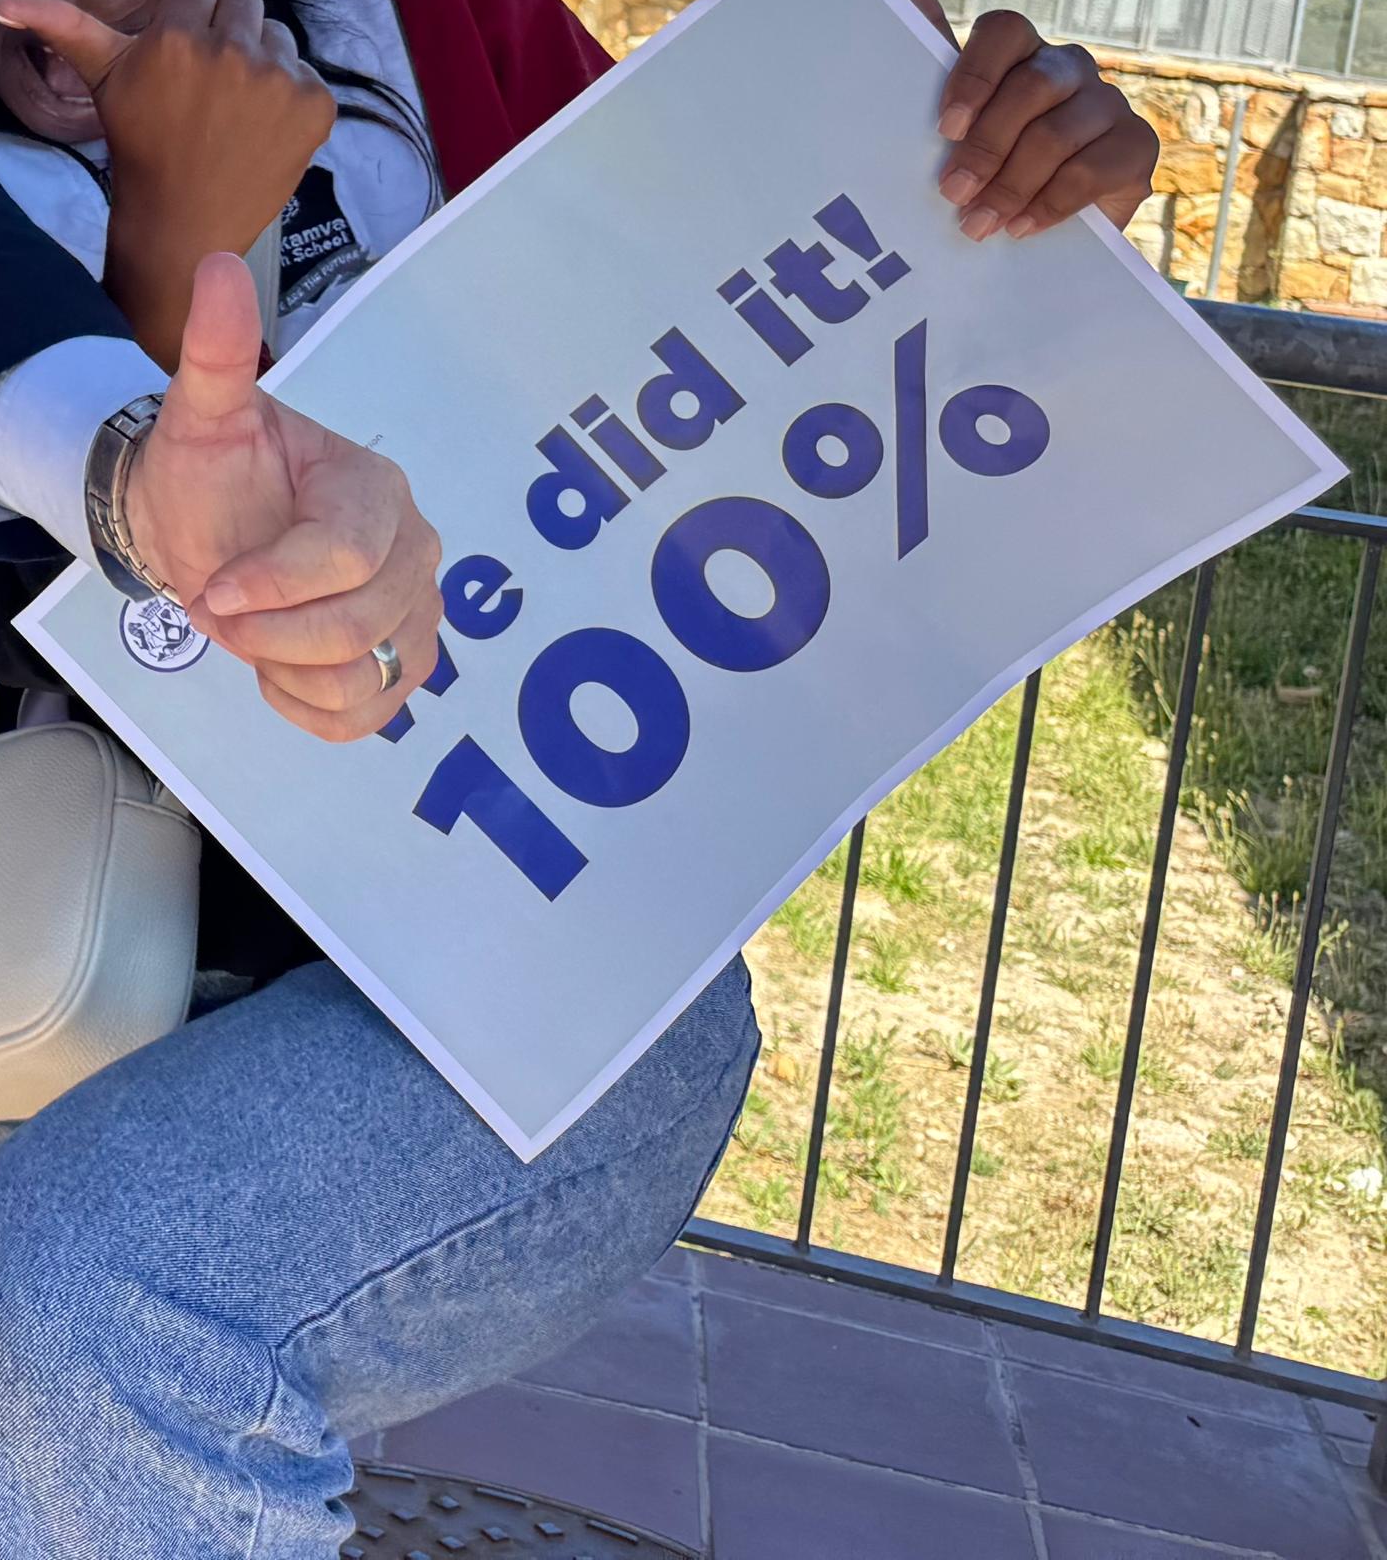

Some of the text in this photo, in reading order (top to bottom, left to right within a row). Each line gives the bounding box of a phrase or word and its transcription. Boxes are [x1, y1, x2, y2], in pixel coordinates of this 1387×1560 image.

[292, 230, 349, 263] School
[526, 326, 747, 551] did
[716, 192, 913, 368] it!
[412, 317, 1051, 902] 100%
